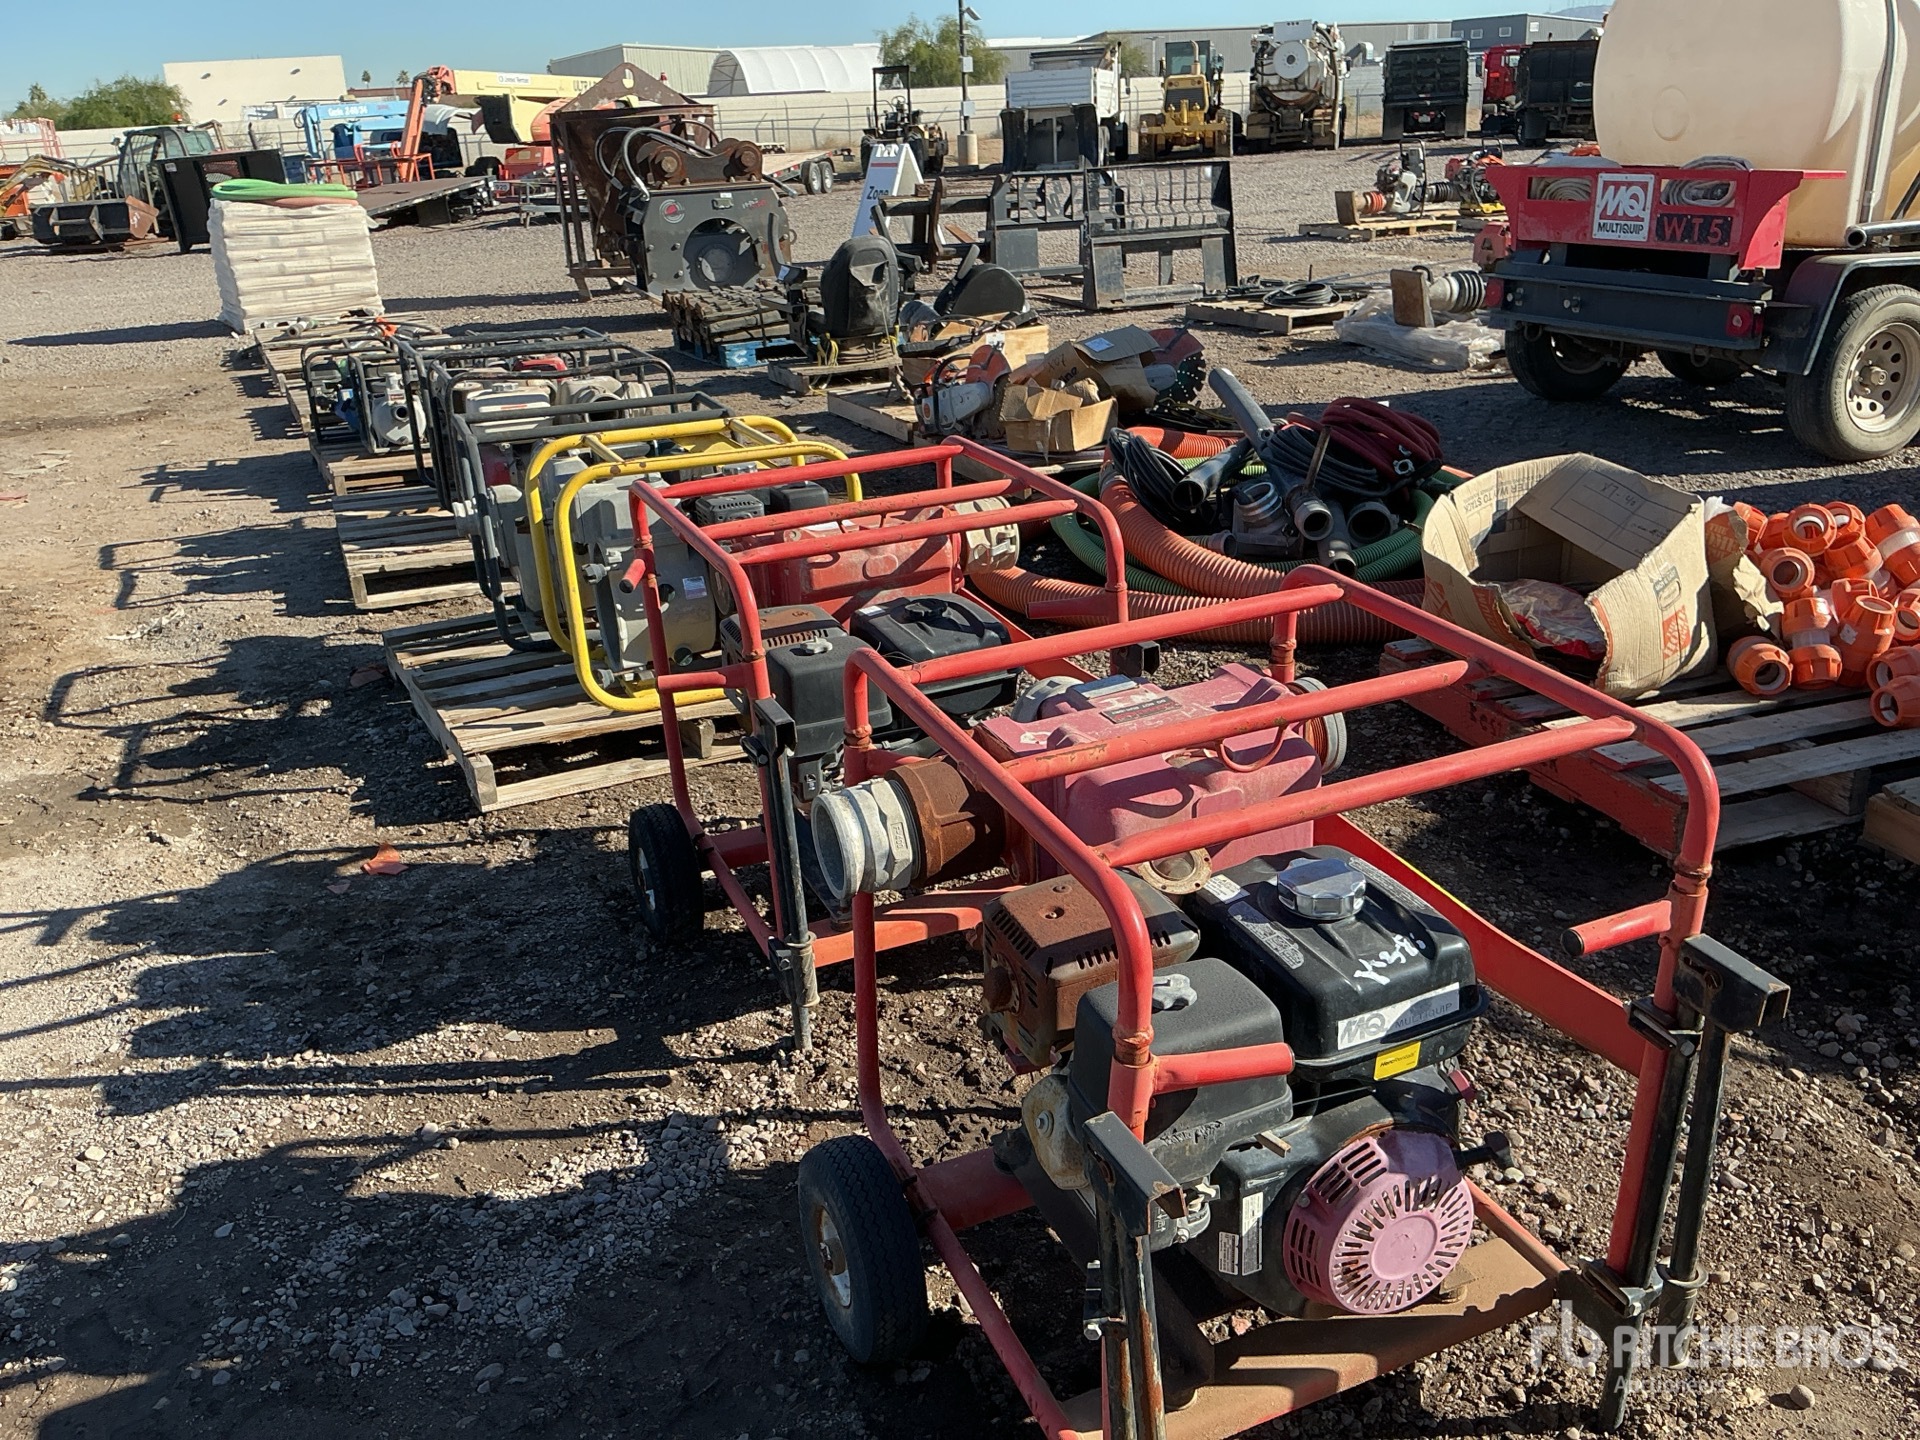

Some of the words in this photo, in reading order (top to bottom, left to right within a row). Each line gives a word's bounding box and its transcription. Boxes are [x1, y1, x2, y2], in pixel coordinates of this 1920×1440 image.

[866, 186, 889, 200] Zone
[1599, 185, 1648, 219] MQ
[1597, 221, 1645, 236] MULTIQUIP
[1340, 1012, 1388, 1044] MQ
[1395, 1002, 1453, 1029] MULTIQUIP
